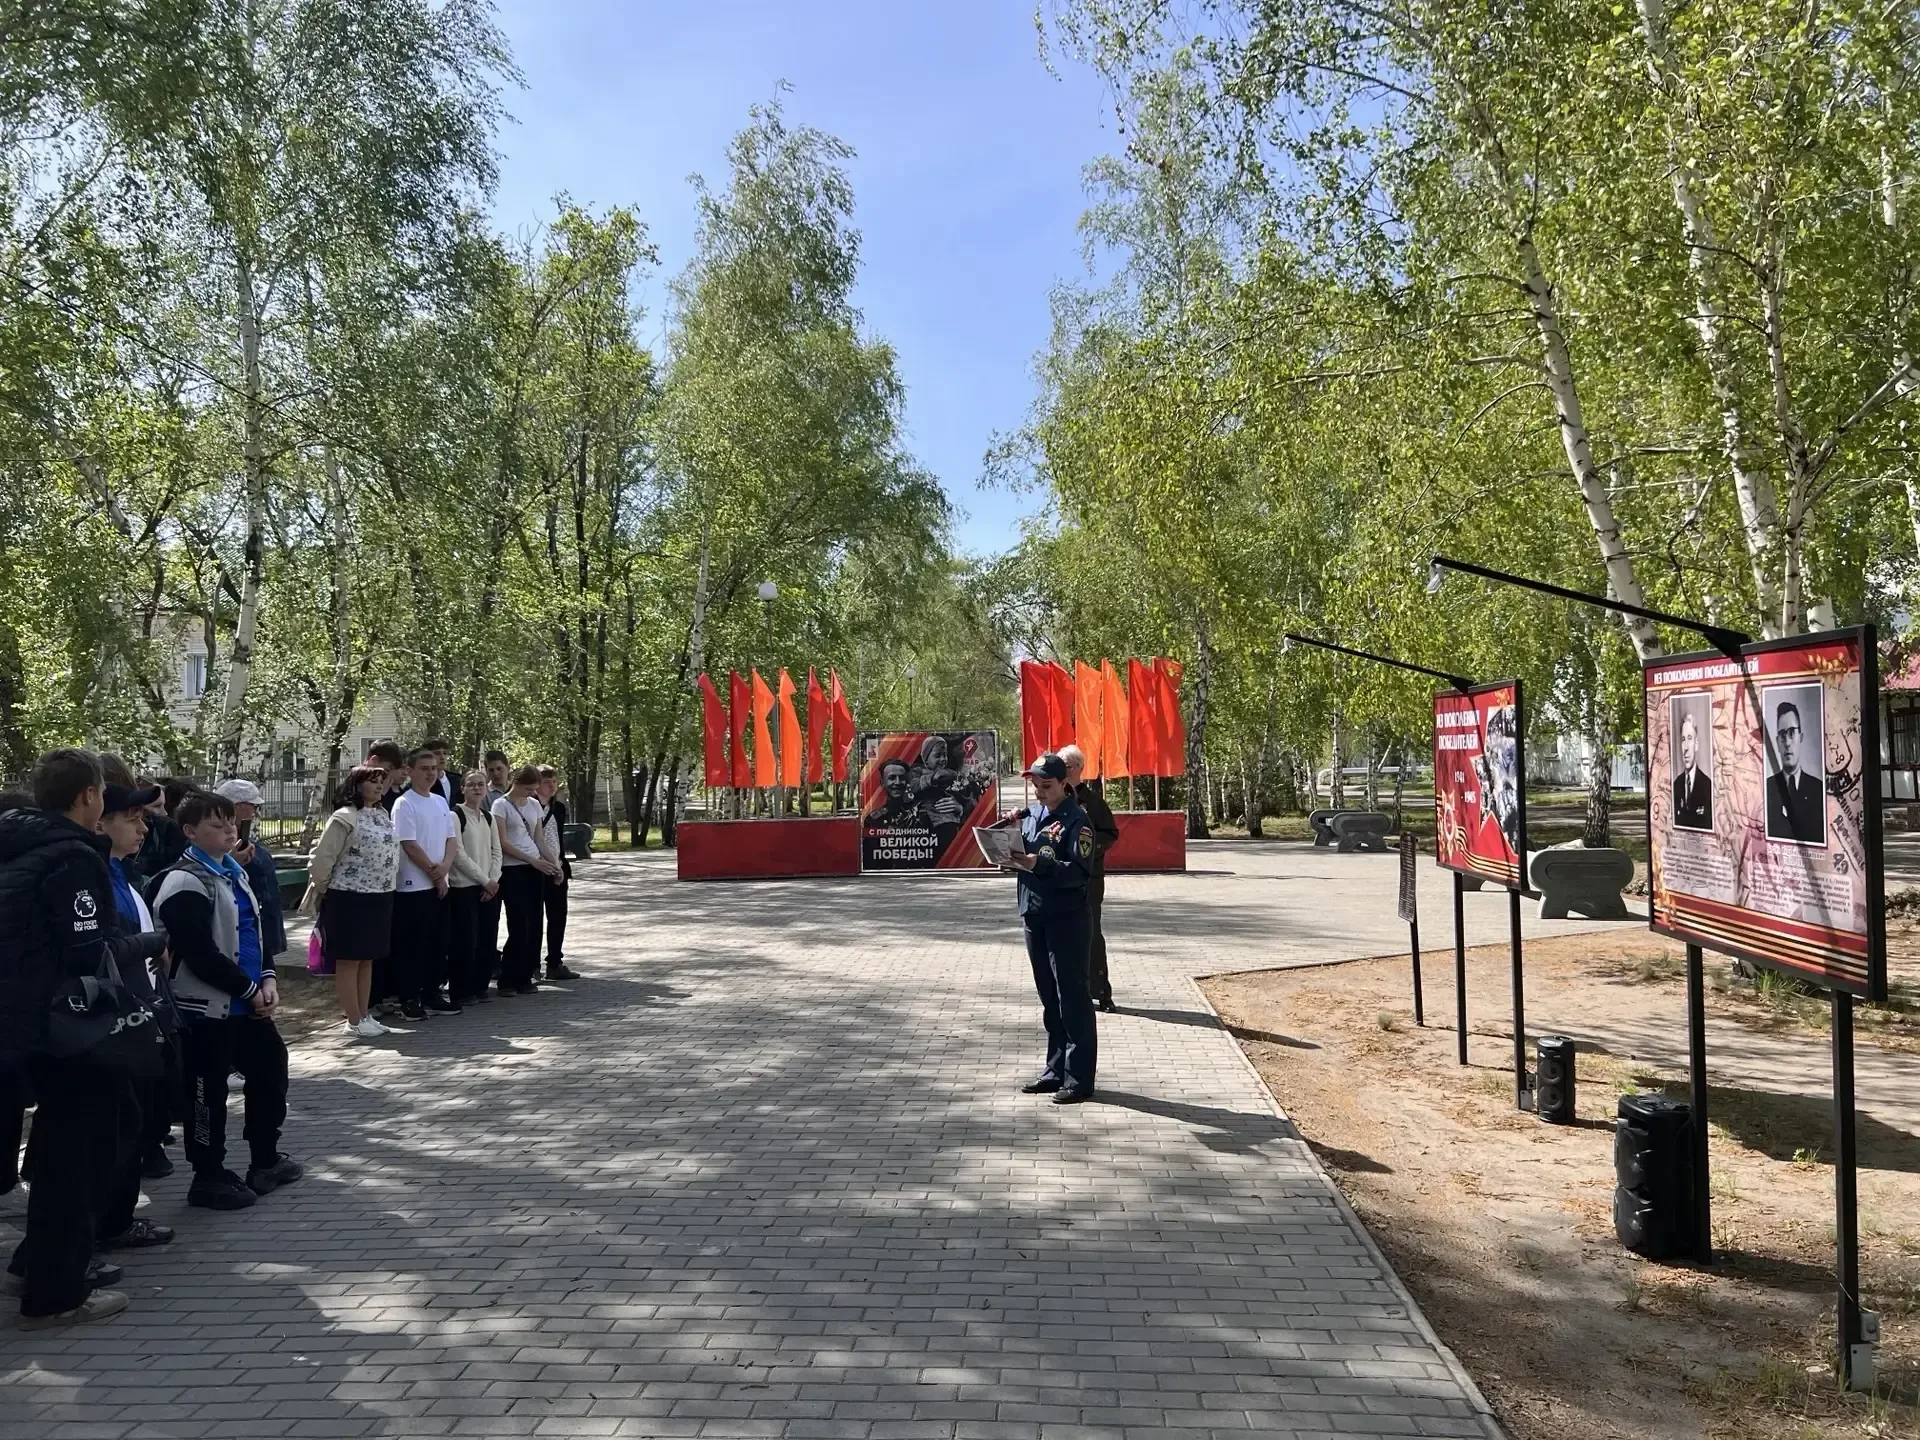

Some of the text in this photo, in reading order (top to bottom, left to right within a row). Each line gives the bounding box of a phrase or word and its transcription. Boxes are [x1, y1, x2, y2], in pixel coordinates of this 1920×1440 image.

[1654, 657, 1759, 685] ИЗ ПОКОЛЕНИЯ ПОБЕДИТЕЛЕЙ
[1436, 710, 1480, 728] ИЗ ПОКОЛЕНИЯ
[1439, 730, 1478, 750] ПОБЕДИТЕЛЕЙ
[1455, 771, 1464, 783] 1941
[876, 828, 929, 836] ПРАЗДНИКОМ
[880, 833, 938, 847] ВЕЛИКОЙ
[873, 848, 934, 861] ПОБЕДЫ!
